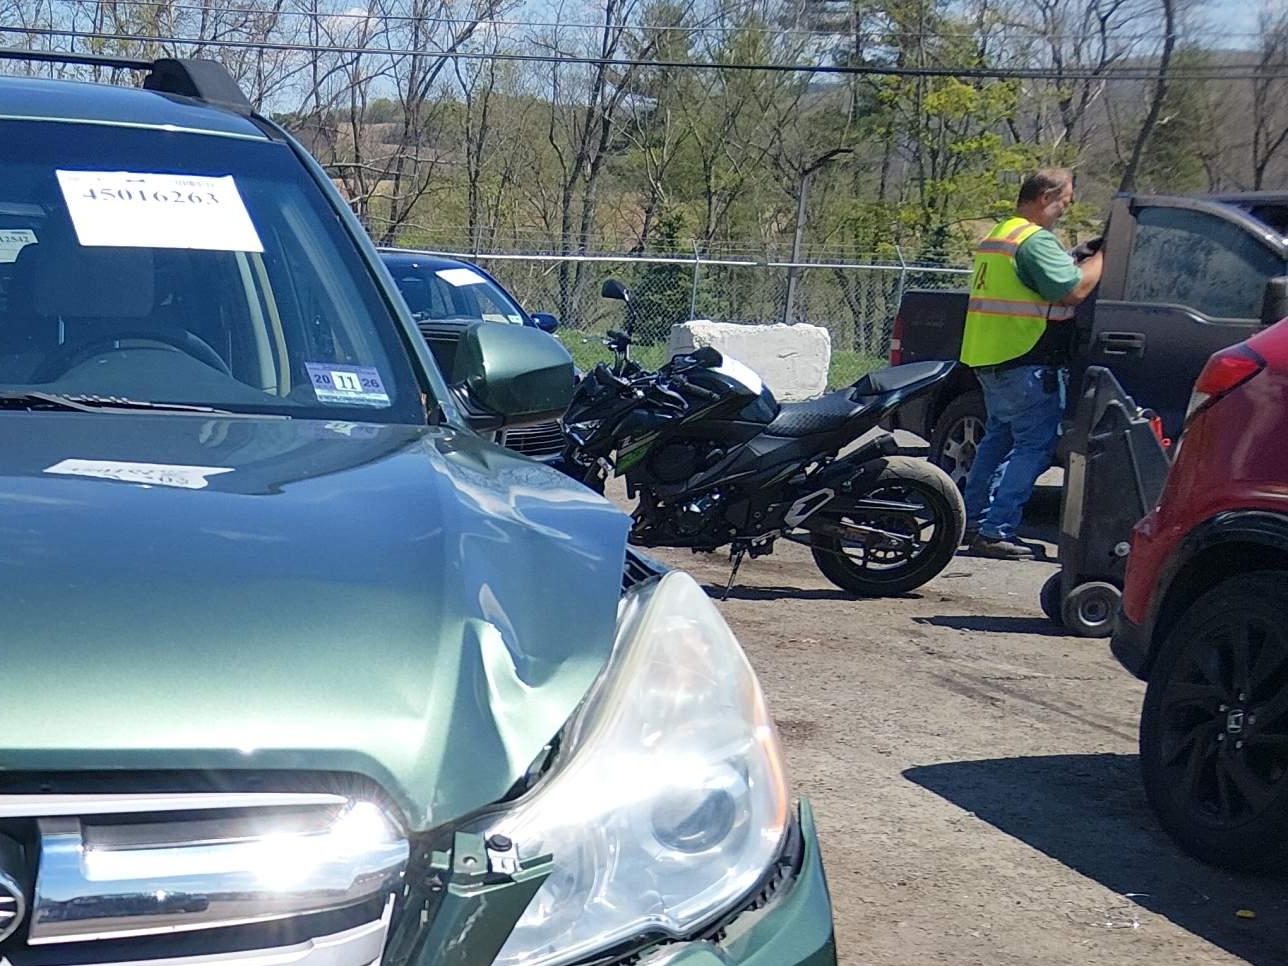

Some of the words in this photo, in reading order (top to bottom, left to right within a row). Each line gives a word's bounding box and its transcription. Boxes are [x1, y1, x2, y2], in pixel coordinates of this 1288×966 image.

[82, 187, 220, 205] 45016263
[314, 374, 330, 384] 20
[338, 375, 357, 389] 11
